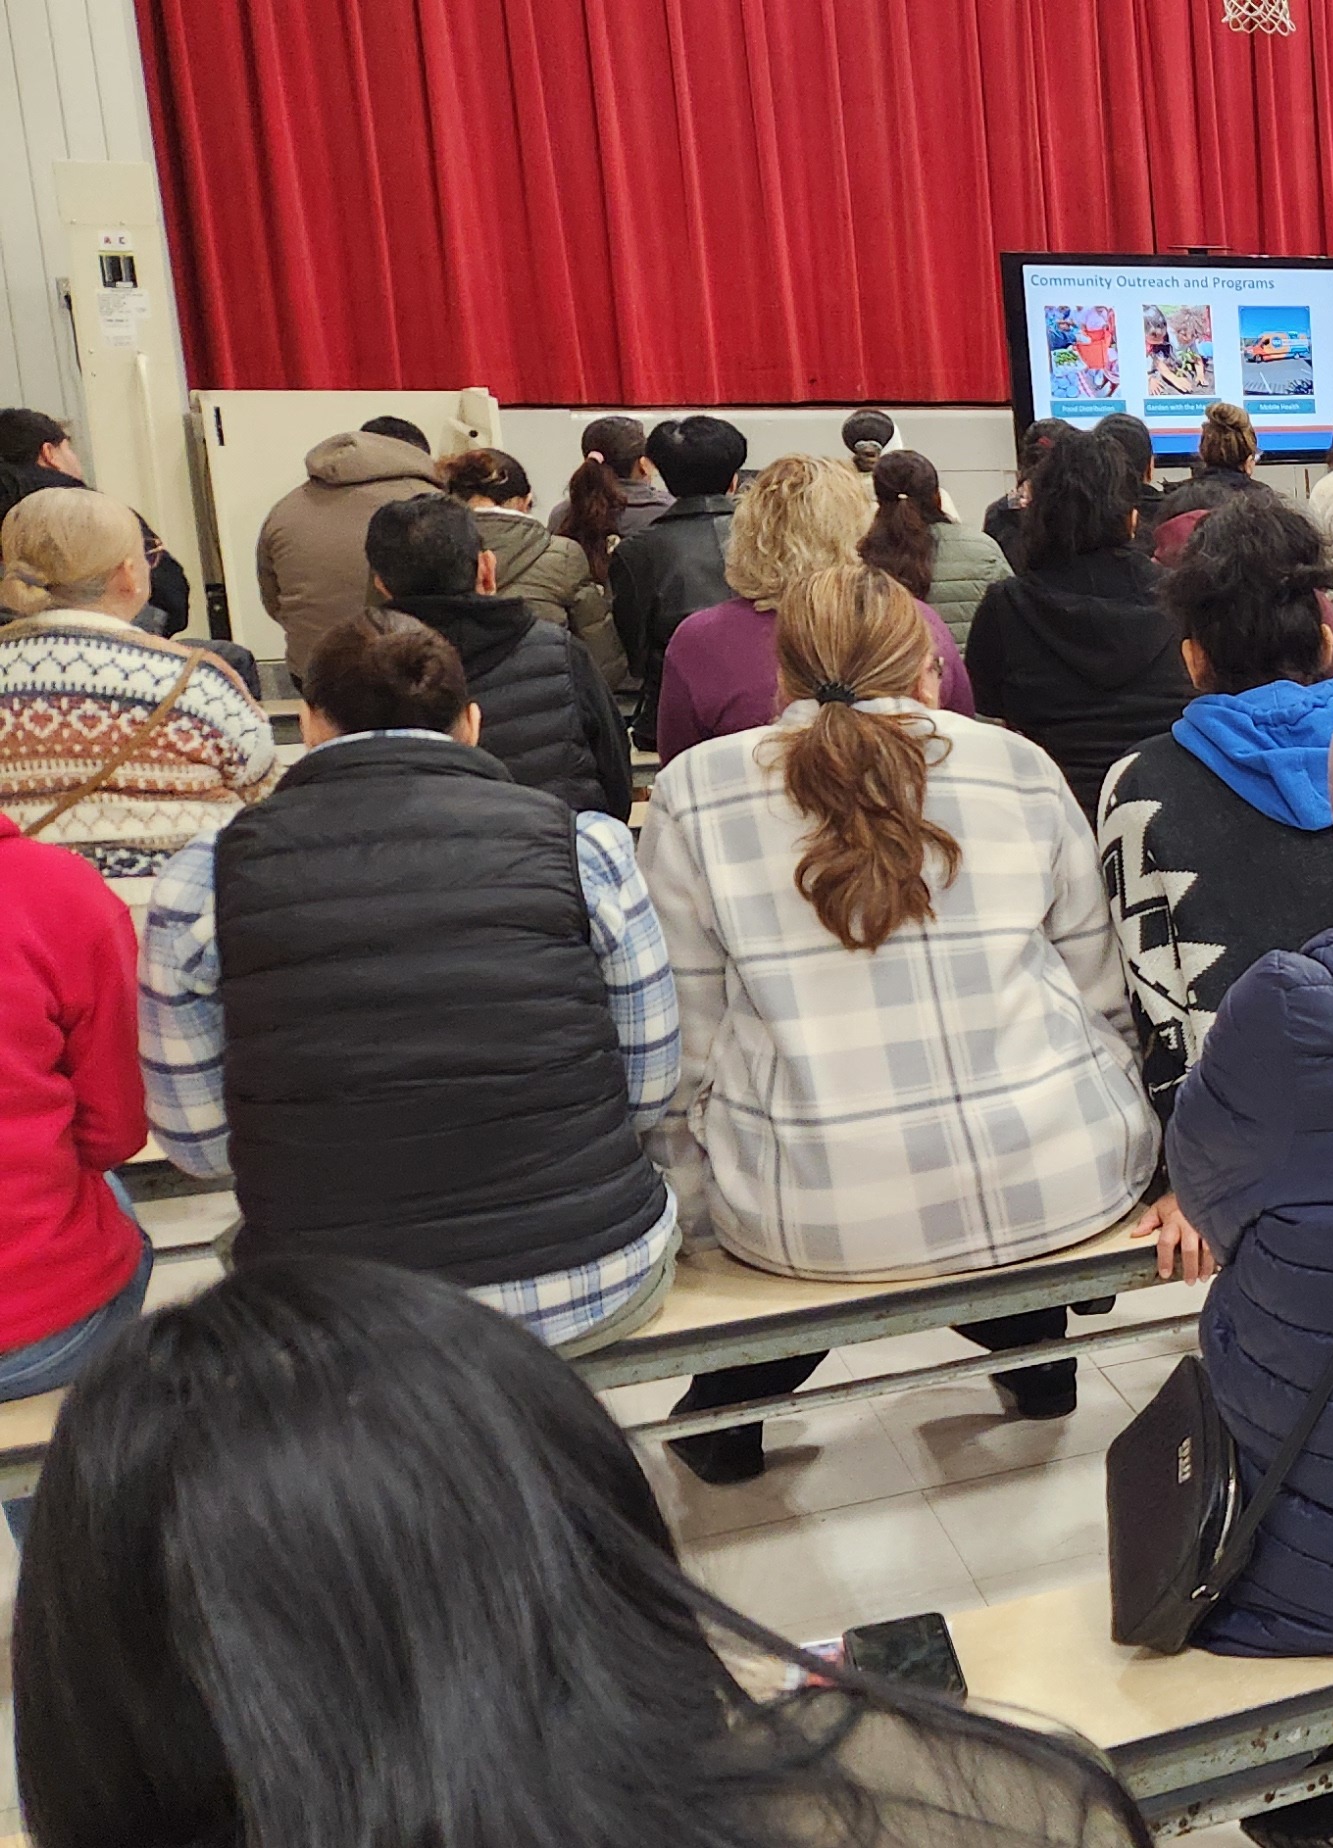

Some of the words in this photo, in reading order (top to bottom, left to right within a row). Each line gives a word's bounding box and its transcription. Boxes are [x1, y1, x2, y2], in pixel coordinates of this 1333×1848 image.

[1030, 274, 1112, 290] Community
[1116, 275, 1180, 288] Outreach
[1183, 276, 1209, 289] and
[1212, 276, 1275, 291] Programs
[1062, 404, 1078, 412] Food
[1079, 404, 1115, 412] Distribution
